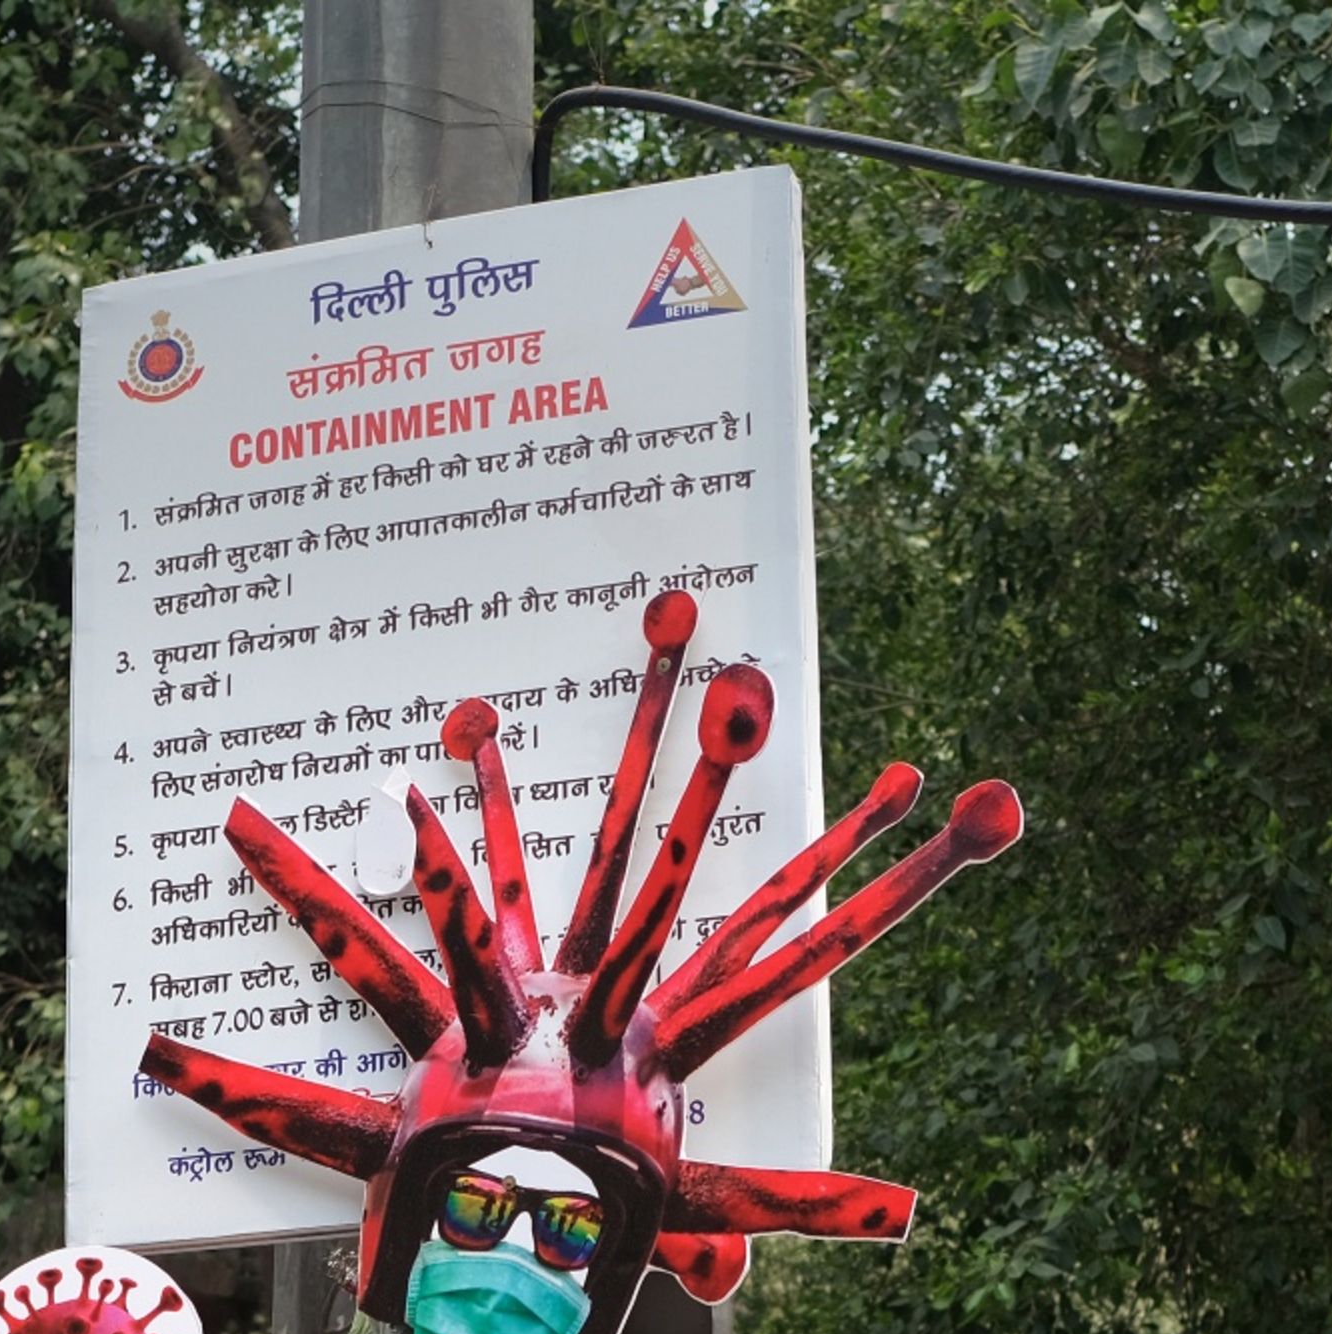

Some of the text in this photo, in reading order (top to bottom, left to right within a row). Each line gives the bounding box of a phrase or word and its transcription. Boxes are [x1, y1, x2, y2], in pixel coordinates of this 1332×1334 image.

[309, 257, 540, 325] दिल्ली पुलिस
[666, 302, 709, 318] BETTER
[286, 329, 546, 399] संक्रमित जगह
[229, 376, 609, 469] CONTAINMENT AREA
[118, 509, 137, 532] 1.
[154, 491, 244, 526] संक्रमित
[247, 483, 308, 510] जगह
[310, 471, 334, 501] में
[337, 474, 369, 499] हर
[371, 457, 435, 491] किसी
[438, 452, 472, 480] को
[475, 452, 511, 474] घर
[514, 439, 538, 469] में
[542, 434, 595, 466] रहने
[598, 427, 633, 456] की
[635, 421, 719, 451] जरूरत
[117, 469, 757, 584] 2. अपनी सुरक्षा के लिए आपातकालीन कर्मचारियों के साथ
[115, 651, 136, 675] 3.
[152, 640, 221, 676] कृपया
[227, 623, 321, 657] नियंत्रण
[328, 615, 371, 643] क्षेत्र
[377, 605, 402, 635] में
[408, 596, 474, 631] किसी
[481, 591, 512, 621] भी
[518, 586, 559, 613] गैर
[565, 571, 651, 612] कानूनी
[153, 582, 242, 617] सहयोग
[151, 679, 177, 707] से
[113, 741, 135, 765] 4.
[152, 727, 212, 759] अपने
[219, 719, 307, 751] स्वास्थ्य
[313, 710, 338, 737] के
[345, 704, 393, 733] लिए
[401, 695, 447, 724] और
[554, 676, 580, 704] के
[151, 770, 197, 799] लिए
[200, 758, 288, 793] संगरोध
[291, 741, 374, 780] नियमों
[377, 745, 411, 768] का
[113, 834, 134, 859] 5.
[151, 825, 221, 861] कृपया
[529, 776, 594, 801] ध्यान
[112, 887, 133, 912] 6.
[150, 872, 213, 907] किसी
[151, 904, 283, 946] अधिकारियों
[111, 982, 133, 1007] 7.
[149, 972, 233, 1002] किराना
[239, 960, 300, 991] स्टोर,
[212, 1006, 265, 1036] 7.00
[268, 997, 314, 1027] बजे
[317, 994, 344, 1023] से
[314, 1048, 348, 1078] की
[167, 1146, 237, 1182] कंट्रोल
